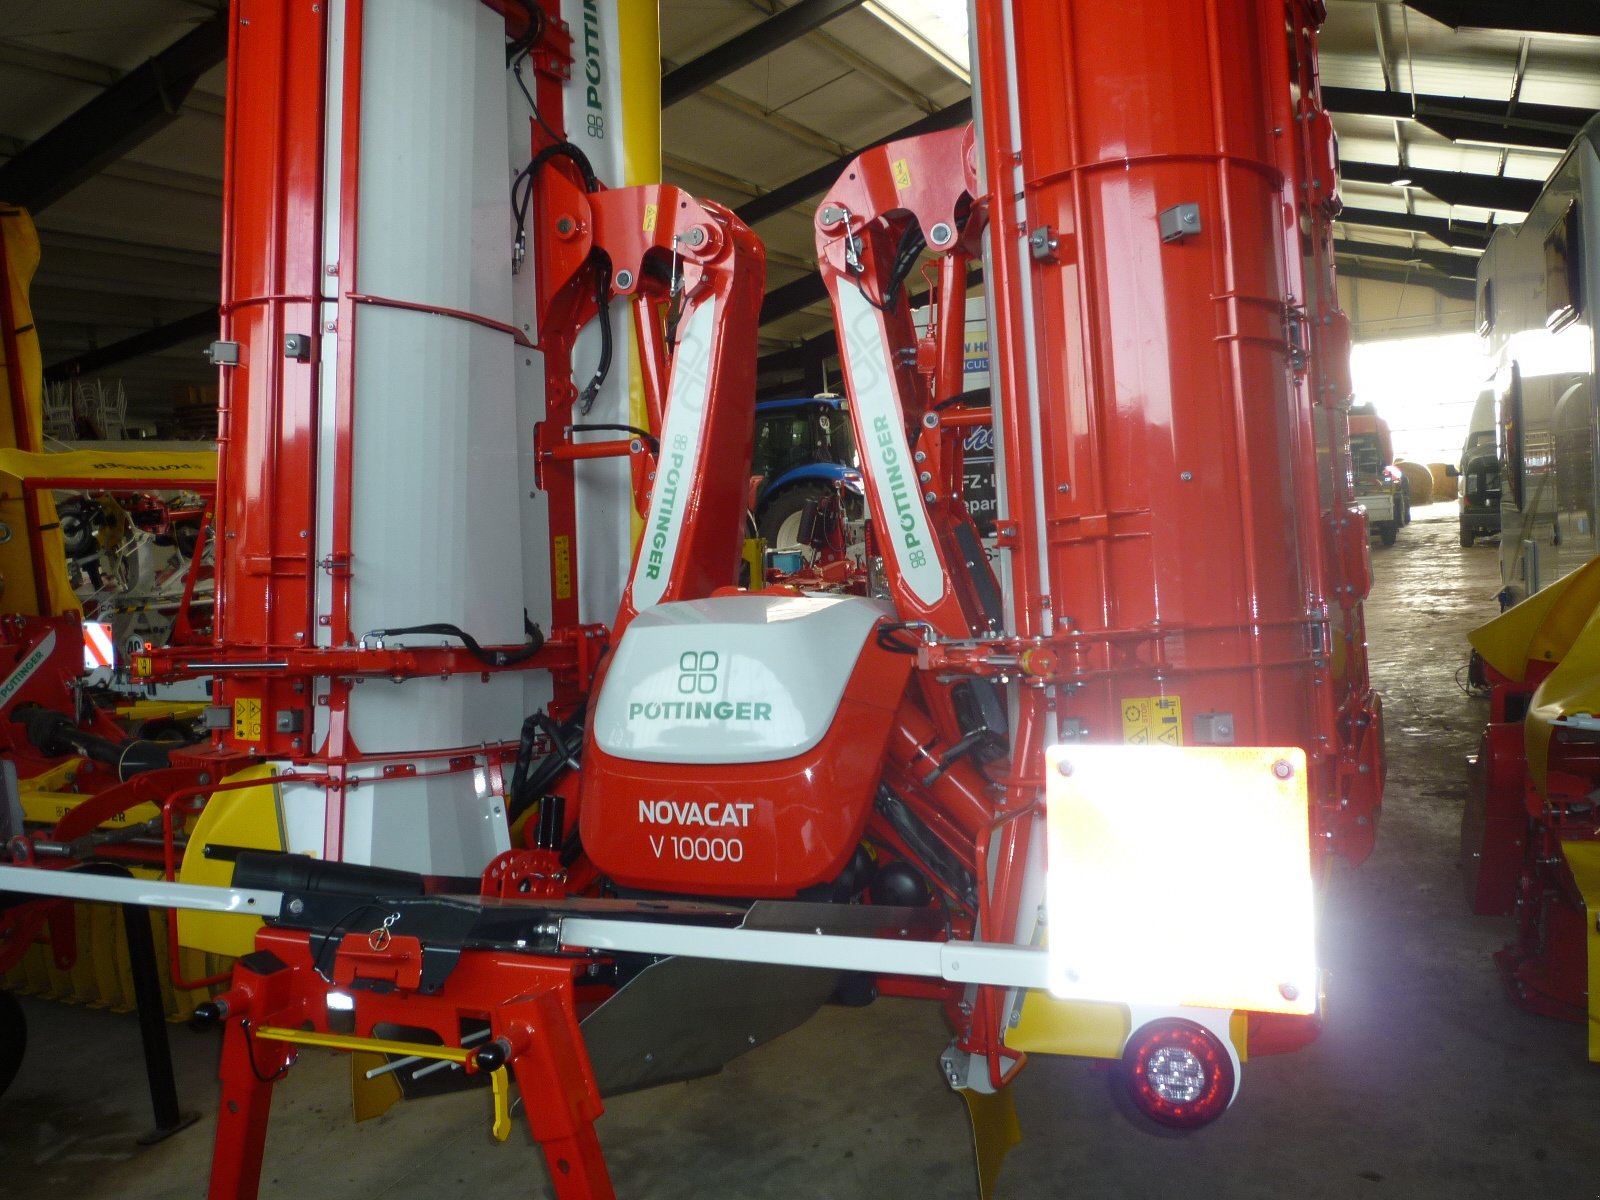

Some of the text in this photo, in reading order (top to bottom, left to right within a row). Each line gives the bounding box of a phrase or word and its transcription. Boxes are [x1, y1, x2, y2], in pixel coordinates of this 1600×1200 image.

[875, 413, 921, 549] PÖTTINGER
[645, 452, 684, 581] PÖTTINGER
[628, 701, 772, 721] PÖTTINGER
[638, 799, 754, 828] NOVACAT
[649, 835, 743, 862] V 10000
